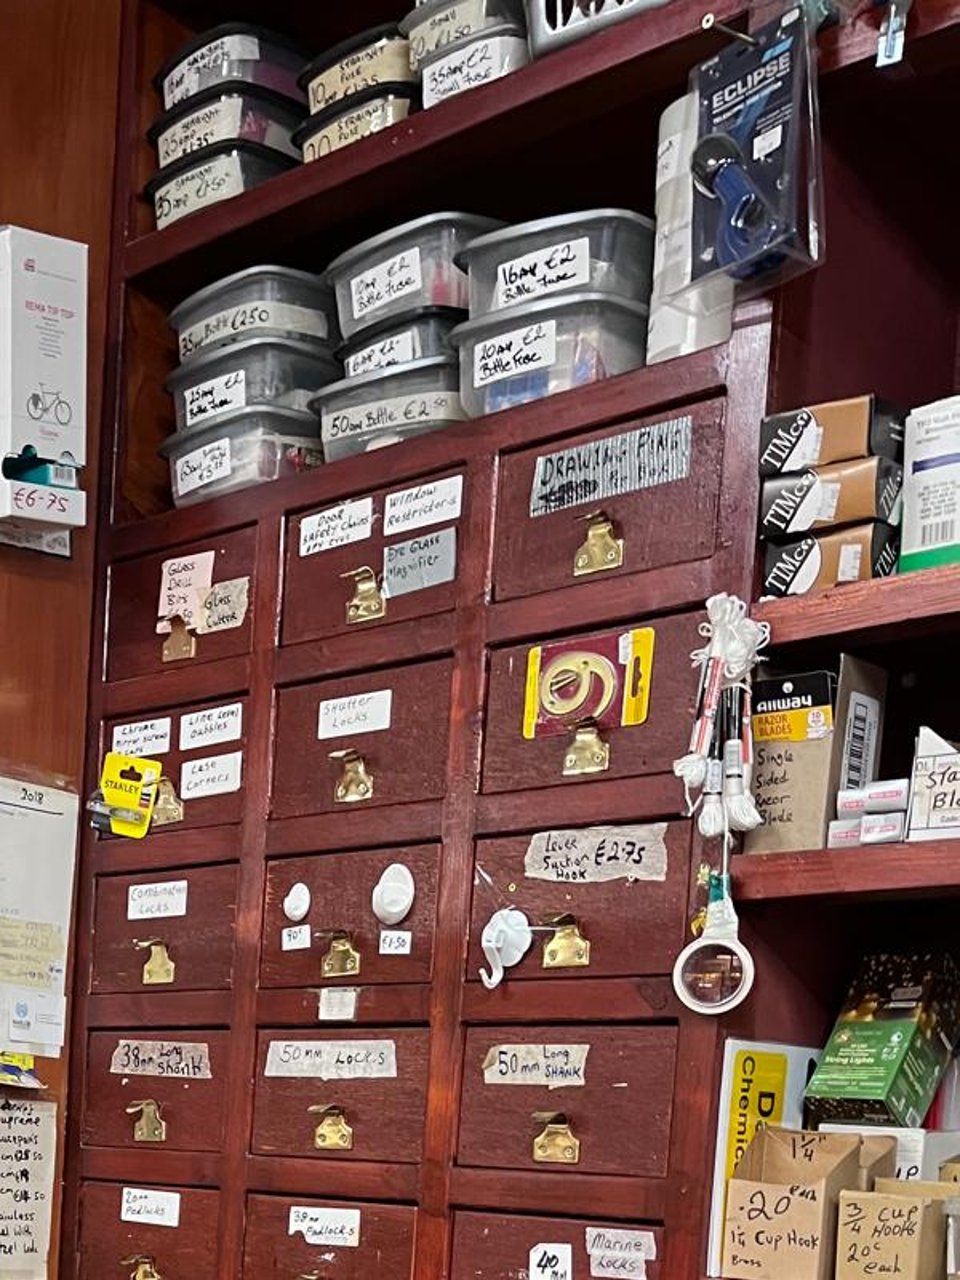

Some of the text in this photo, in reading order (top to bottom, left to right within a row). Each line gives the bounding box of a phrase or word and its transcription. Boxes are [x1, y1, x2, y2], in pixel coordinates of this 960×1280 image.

[712, 52, 792, 109] ECLIPSE
[759, 407, 811, 473] TIMco
[763, 469, 818, 534] TIMco
[764, 536, 816, 594] TIMco
[104, 780, 139, 794] STANLEY
[537, 1251, 559, 1275] 40
[591, 1232, 643, 1251] Marine
